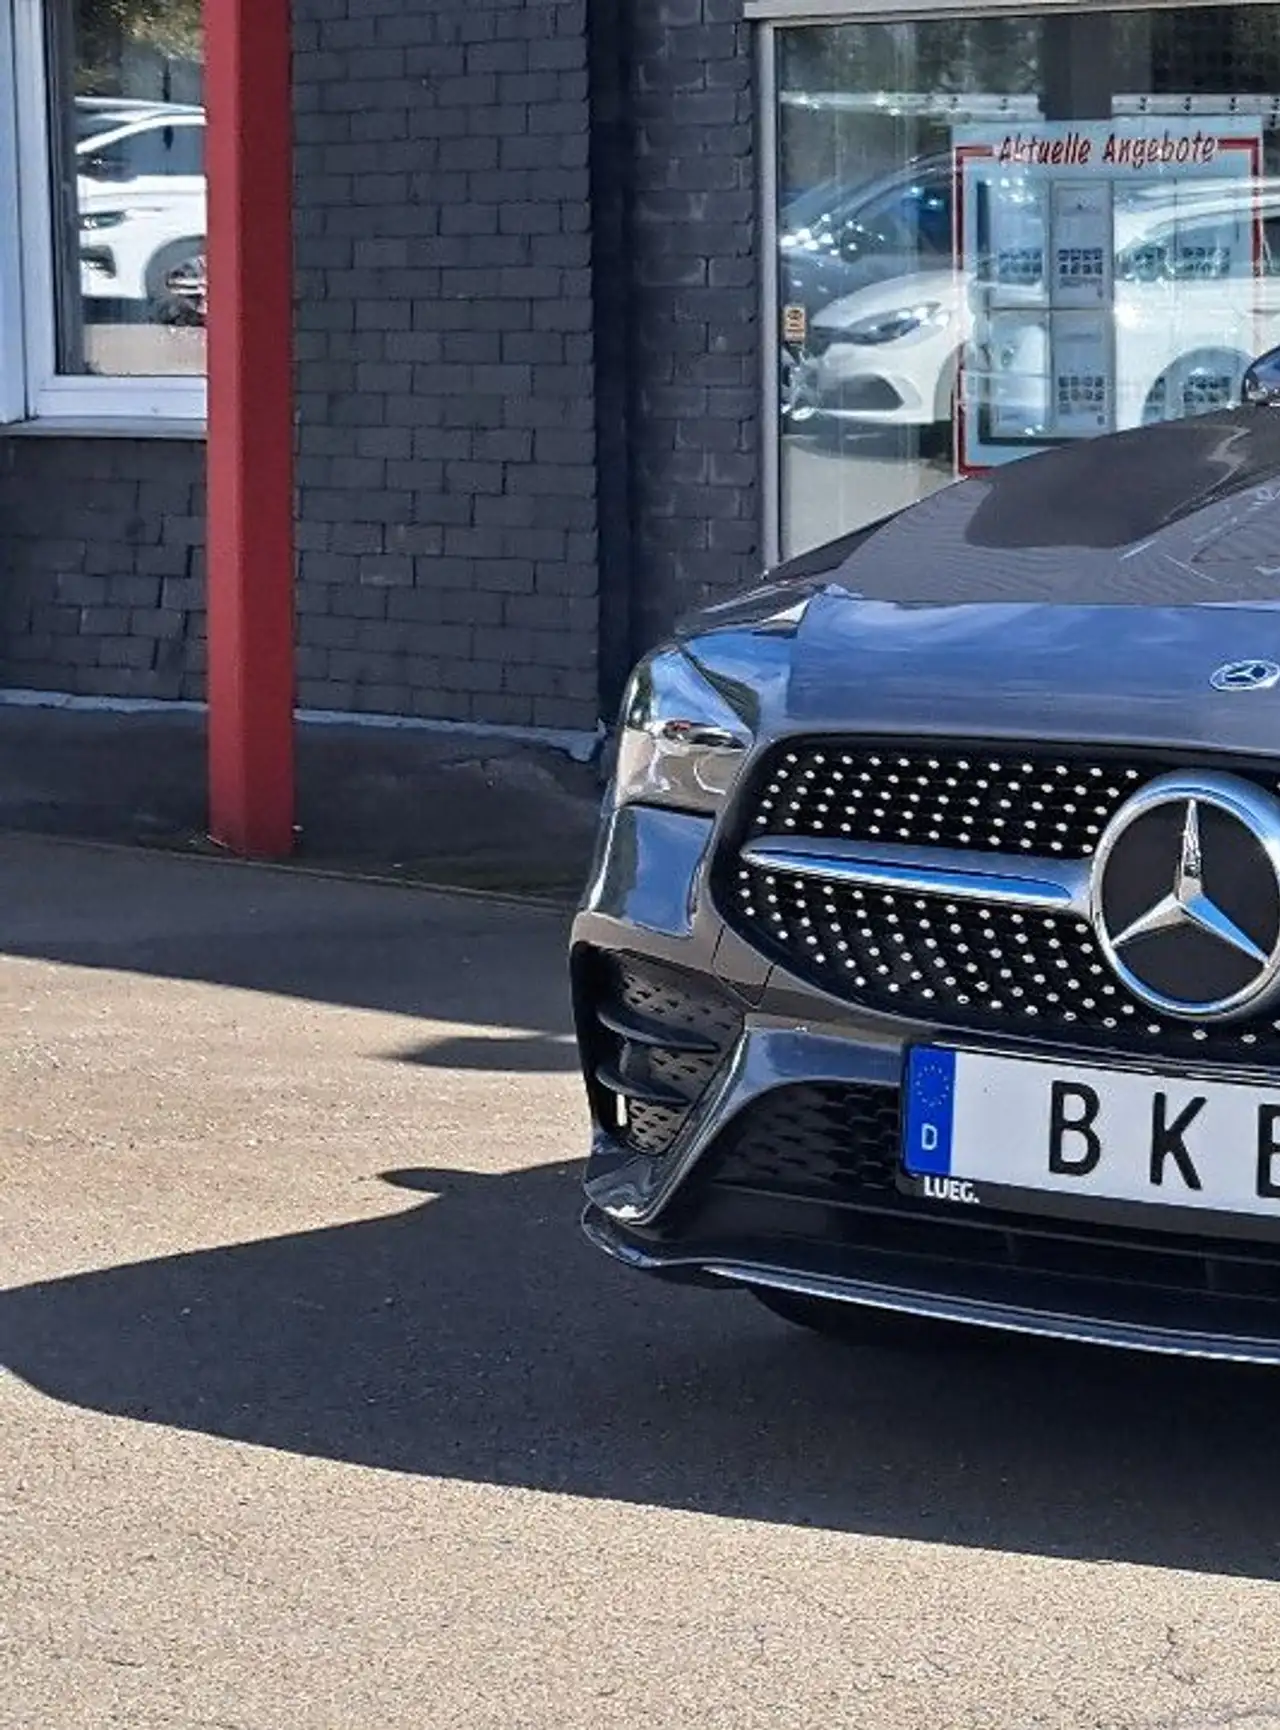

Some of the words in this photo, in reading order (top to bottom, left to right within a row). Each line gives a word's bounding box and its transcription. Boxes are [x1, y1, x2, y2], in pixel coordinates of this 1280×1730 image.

[999, 132, 1091, 165] Aktuelle
[1102, 129, 1218, 169] Angebote
[921, 1123, 938, 1150] D
[1049, 1080, 1101, 1177] B
[1150, 1092, 1207, 1190] K
[924, 1176, 980, 1204] LUEG.
